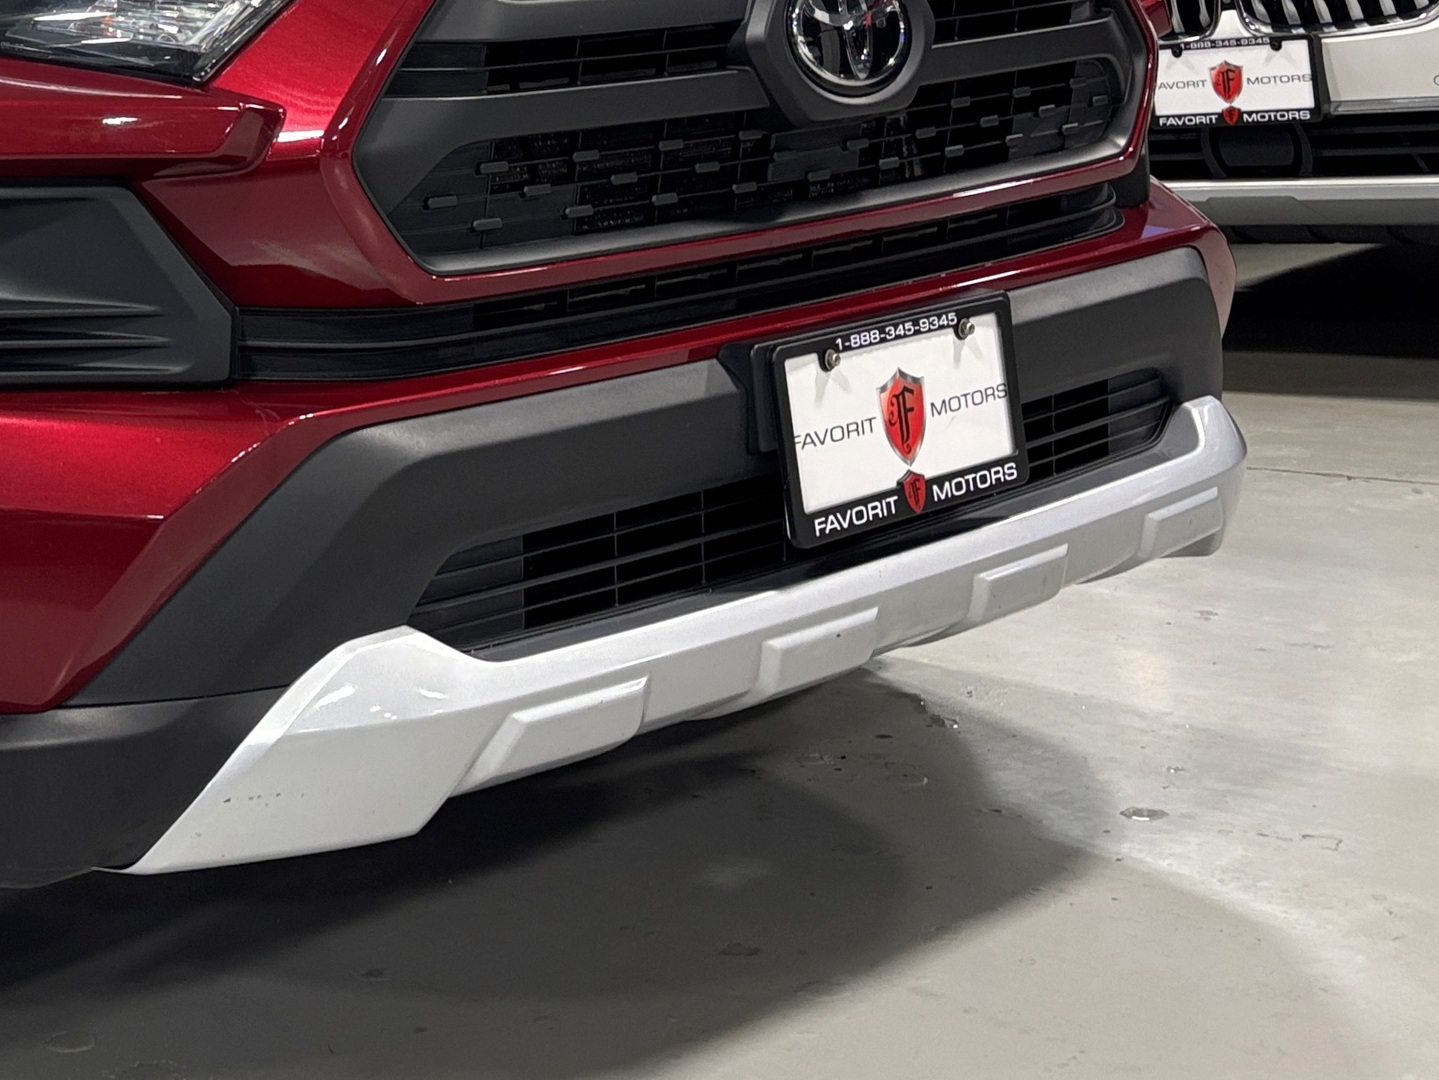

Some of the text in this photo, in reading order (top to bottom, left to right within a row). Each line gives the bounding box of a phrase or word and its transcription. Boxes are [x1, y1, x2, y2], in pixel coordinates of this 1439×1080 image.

[1158, 74, 1312, 90] AVORIT MOTORS
[1159, 114, 1219, 127] FAVORIT
[1243, 110, 1311, 123] MOTORS
[835, 312, 958, 351] 1-888-345-9345
[930, 382, 1008, 418] MOTORS
[814, 462, 1018, 538] FAVORIT MOTORS
